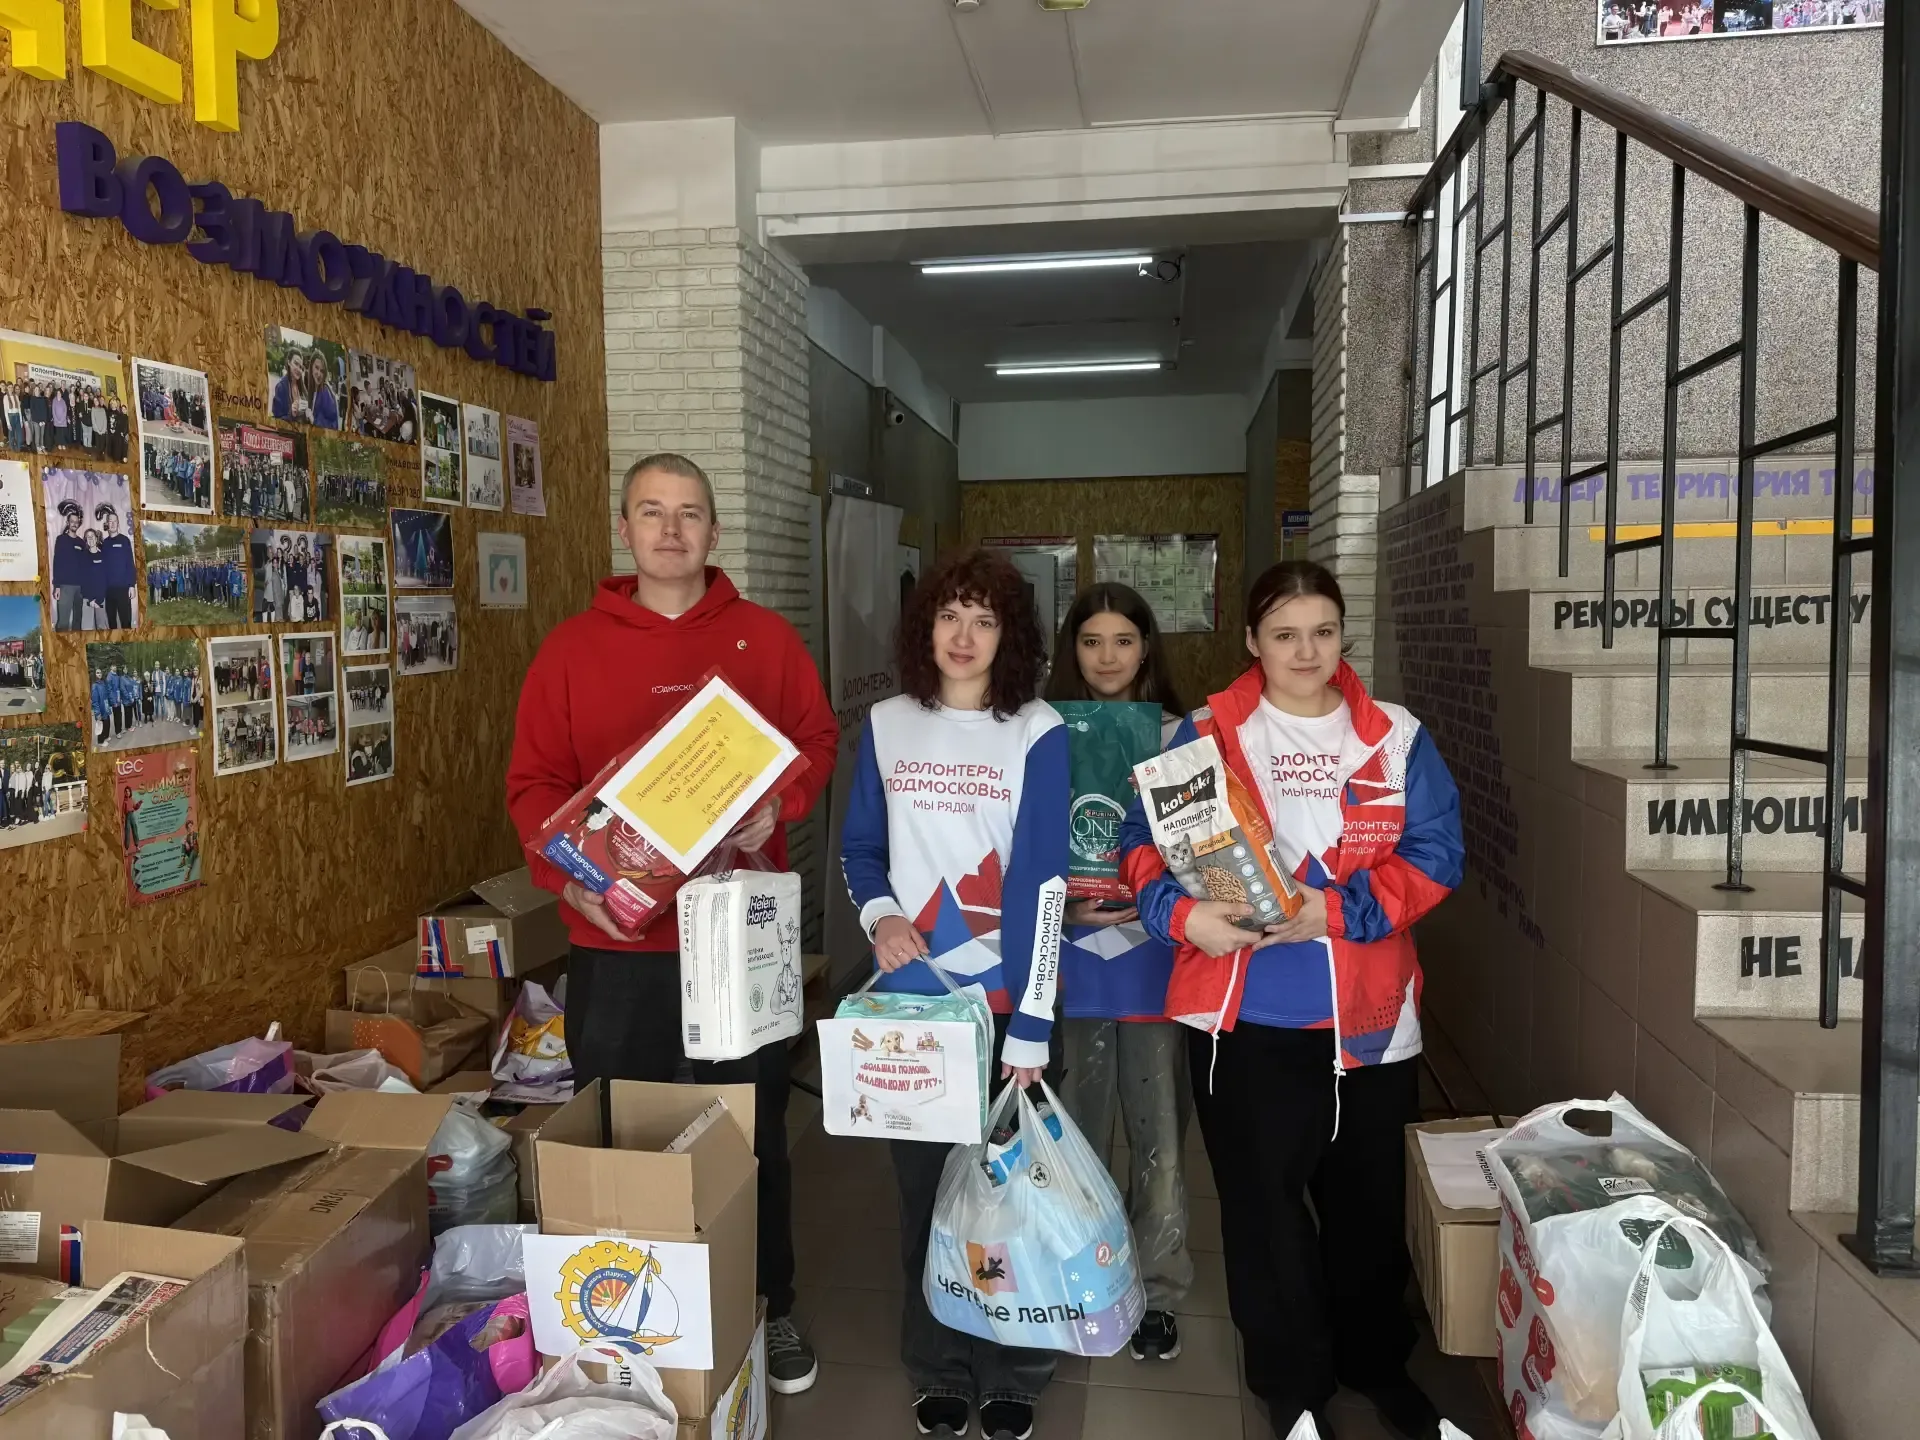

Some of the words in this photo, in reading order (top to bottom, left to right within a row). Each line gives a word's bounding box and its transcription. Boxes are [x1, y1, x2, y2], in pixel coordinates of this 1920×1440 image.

[56, 121, 557, 382] ВОЗМОЖНОСТЕЙ
[1627, 469, 1811, 500] ТЕРИТРИЯ
[1554, 598, 1694, 630] РЕКОРДЫ
[1704, 594, 1871, 629] СУЩЕСТУ
[842, 671, 894, 702] ВОЛОНТЕРЫ
[679, 724, 710, 759] отделение
[661, 785, 682, 805] МОУ
[682, 749, 718, 786] «Гимназия
[723, 735, 731, 743] 5
[668, 740, 710, 785] «Солнышко»
[894, 760, 1004, 781] ВОЛОНТЕРЫ
[137, 774, 192, 796] SUMMER
[685, 756, 726, 799] «Интеллект»
[885, 776, 1012, 803] ПОДМОСКОВЬЯ
[1281, 787, 1304, 798] МЫ
[913, 800, 935, 813] МЫ
[937, 801, 975, 815] РЯДОМ
[1163, 804, 1217, 832] НАПОЛНИТЕЛЬ
[1647, 796, 1868, 838] ИМЕЮЩИ
[1072, 815, 1120, 839] ONE
[559, 839, 574, 854] ДЛЯ
[572, 850, 606, 884] ВЗРОСЛЫХ
[1348, 847, 1376, 855] РЯДОМ
[749, 893, 778, 912] Helen
[746, 909, 778, 929] Harper
[1033, 889, 1056, 1001] ПОДМОСКОВЬЯ
[1047, 891, 1064, 982] ВОЛОНТЕРЫ
[1741, 936, 1802, 978] НЕ
[855, 1073, 911, 1091] МАЛЕНЬКОМУ
[914, 1077, 943, 1091] ДРУГУ»
[859, 1062, 897, 1074] «БОЛЬШАЯ
[898, 1064, 931, 1075] ПОМОЩЬ
[884, 1113, 912, 1122] ПОМОЩЬ
[1018, 1302, 1087, 1324] лапы
